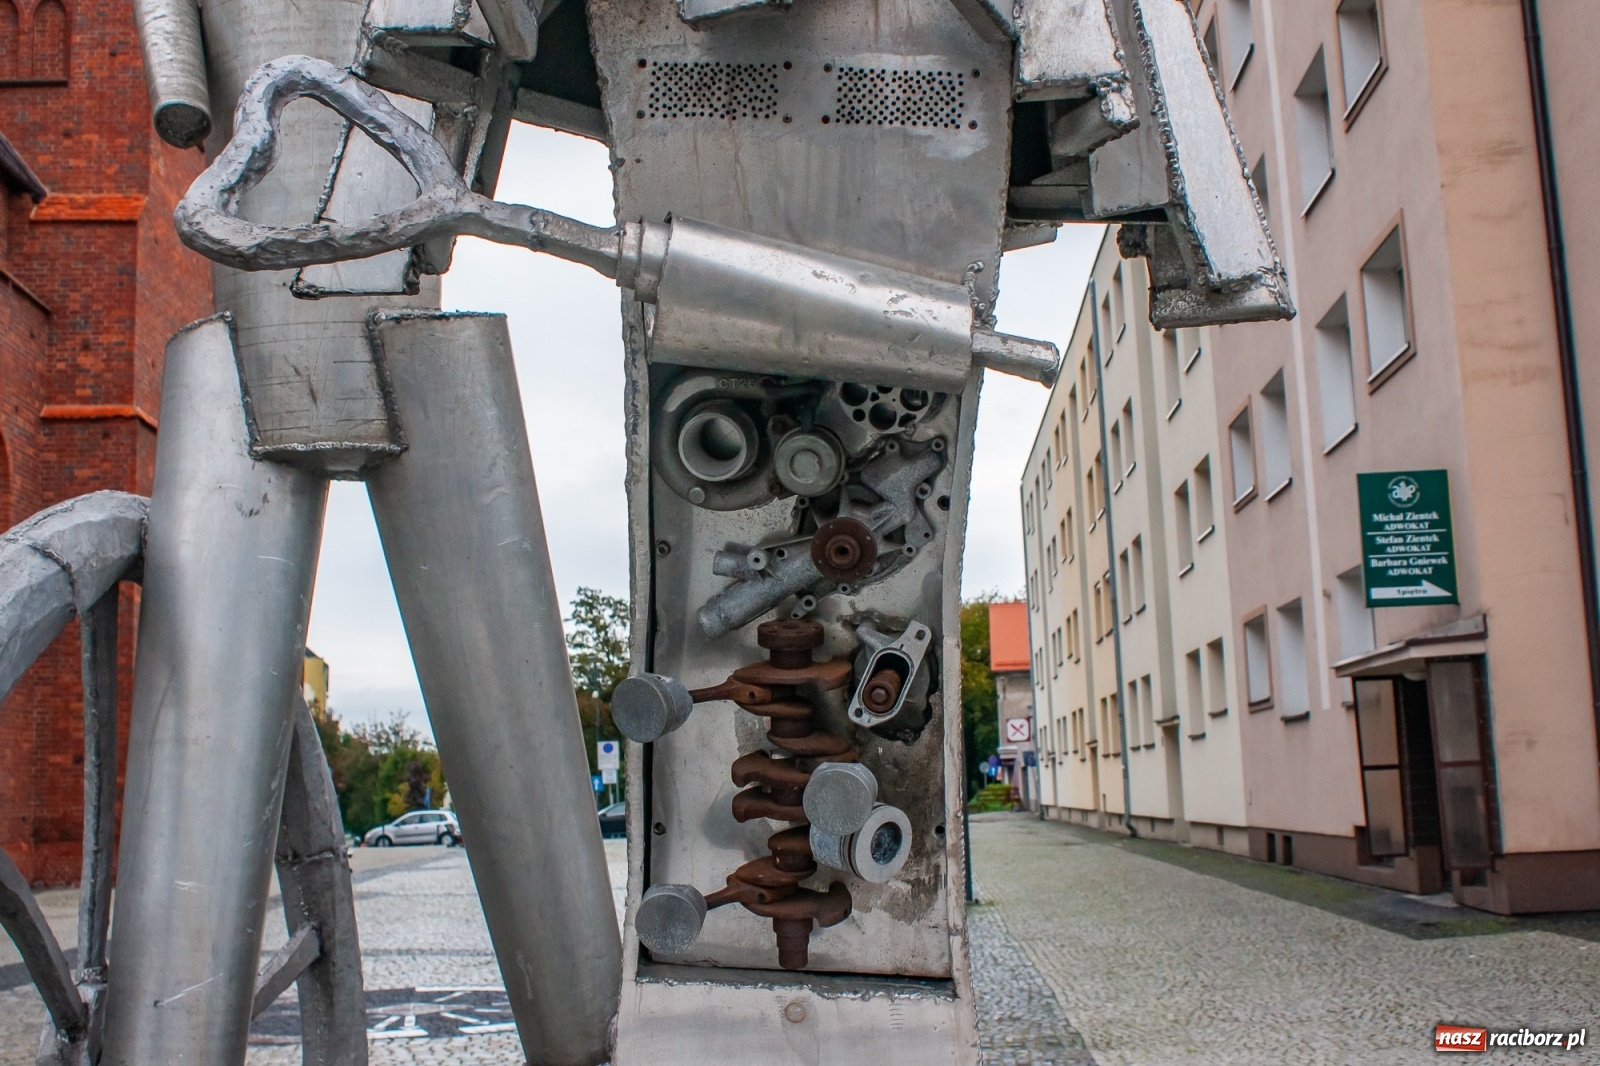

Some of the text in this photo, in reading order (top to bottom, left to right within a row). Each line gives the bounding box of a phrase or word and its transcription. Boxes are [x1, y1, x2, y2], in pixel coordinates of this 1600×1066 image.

[1385, 521, 1429, 531] ADWOKAT
[1376, 535, 1404, 545] Stefan
[1386, 544, 1431, 553] ADWOKAT
[1371, 556, 1448, 568] Barbara Gniewek
[1388, 566, 1433, 576] ADWOKAT
